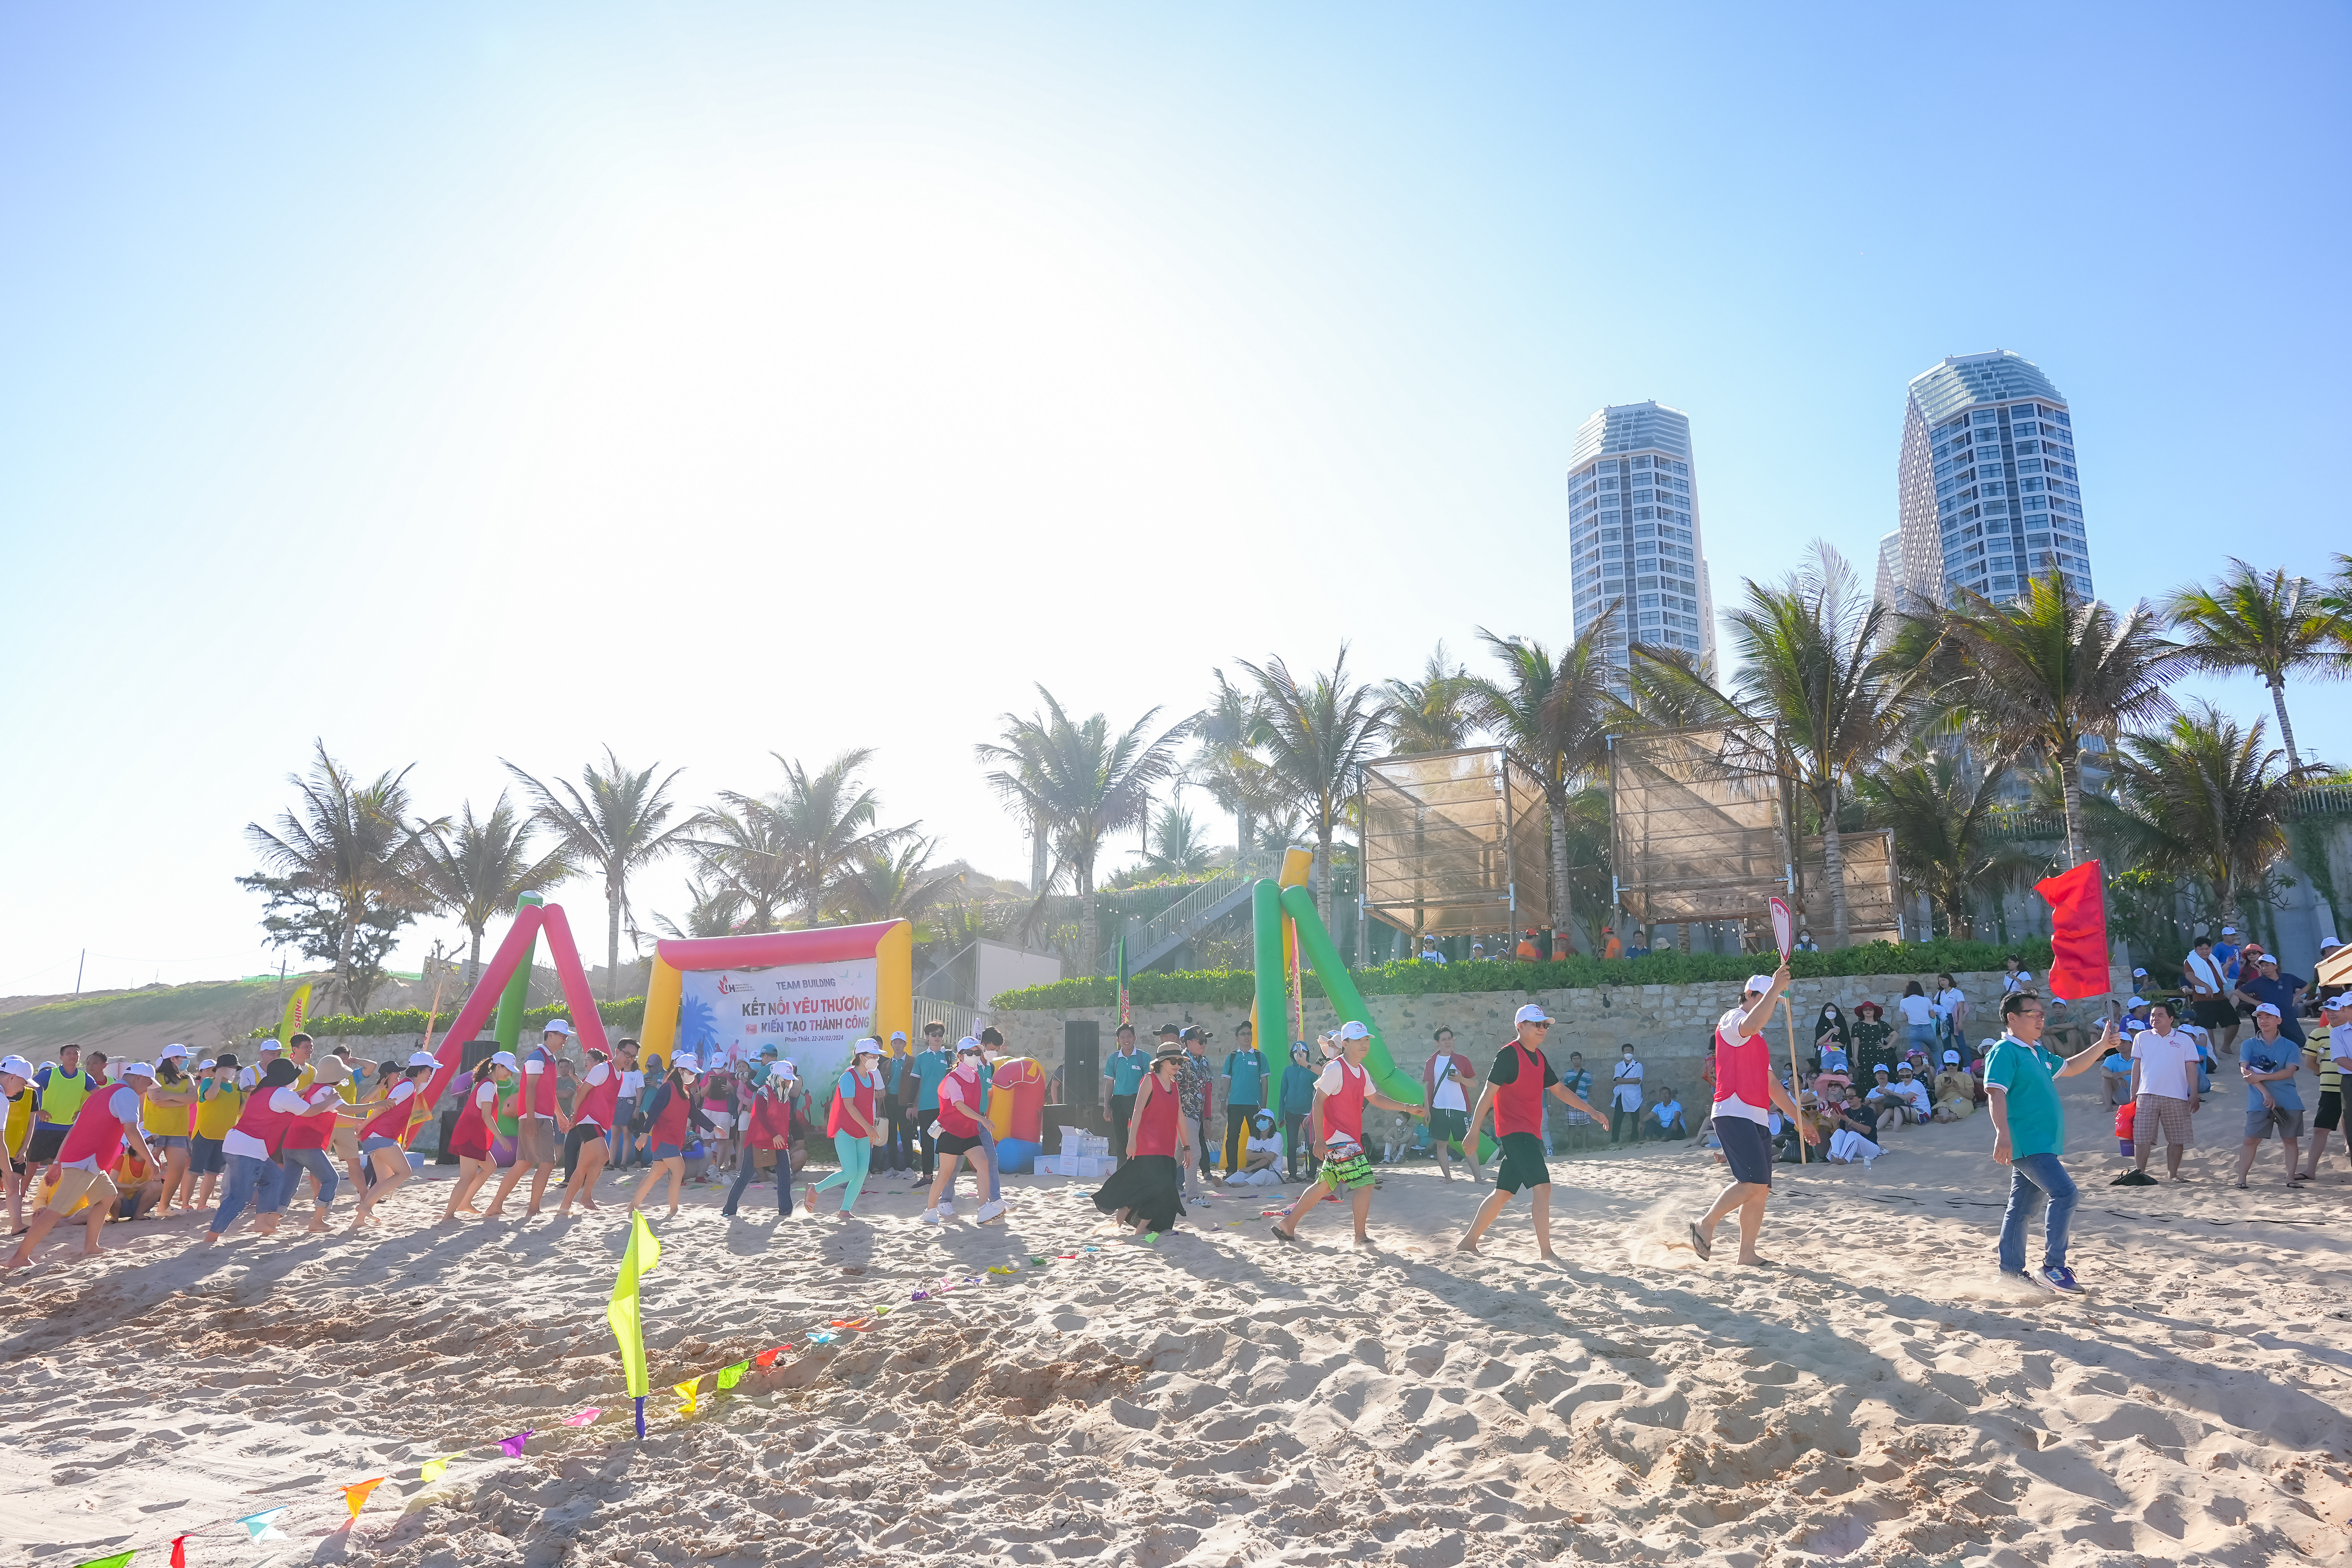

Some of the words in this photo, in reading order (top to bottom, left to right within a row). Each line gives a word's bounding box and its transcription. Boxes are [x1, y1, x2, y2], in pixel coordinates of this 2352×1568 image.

[776, 980, 800, 990] TEAM
[802, 978, 836, 988] BUILDING
[294, 997, 303, 1029] SHINE
[742, 997, 766, 1016] KẾT
[768, 996, 789, 1015] NỐI
[792, 997, 818, 1014] YÊU
[821, 995, 870, 1012] THƯƠNG
[761, 1018, 784, 1033] KIẾN
[786, 1021, 807, 1034] TẠO
[809, 1016, 842, 1031] THÀNH
[845, 1014, 870, 1029] CÔNG
